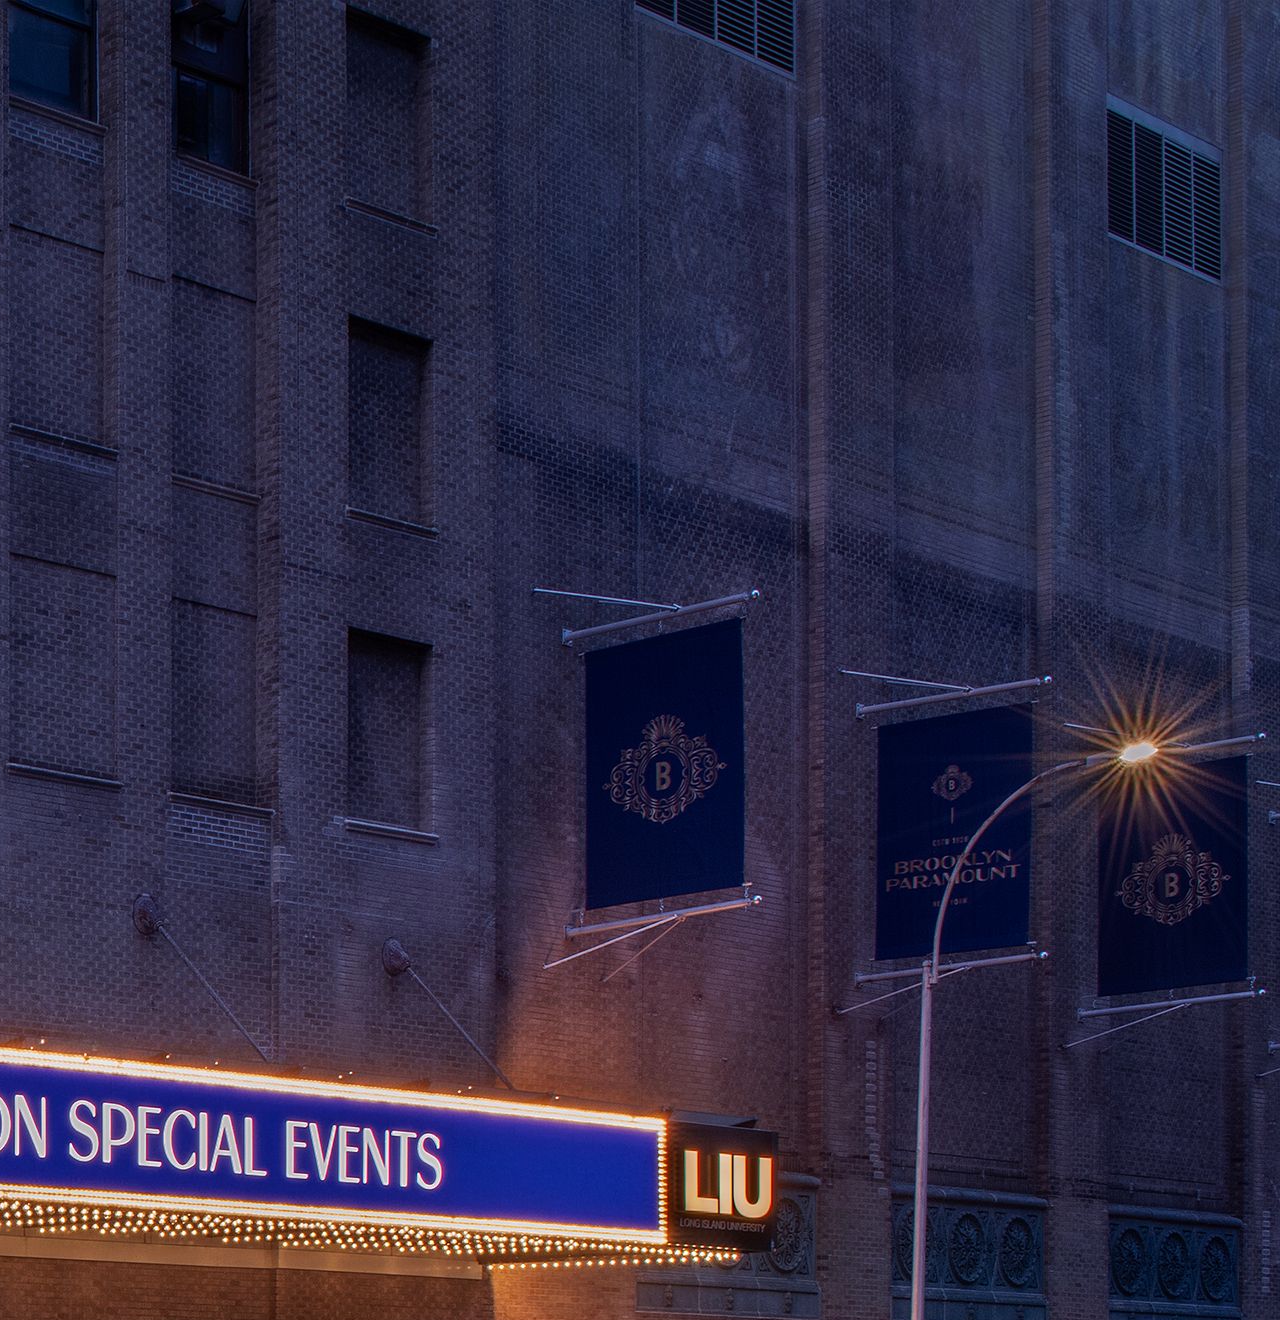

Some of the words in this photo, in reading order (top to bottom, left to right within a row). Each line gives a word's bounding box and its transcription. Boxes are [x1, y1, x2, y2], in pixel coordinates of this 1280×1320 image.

[656, 762, 671, 791] B
[1164, 873, 1180, 897] B
[66, 1098, 268, 1178] SPECIAL
[285, 1119, 444, 1190] EVENTS
[684, 1150, 773, 1219] LIU
[680, 1218, 700, 1228] LONG
[701, 1219, 726, 1230] ISLAND
[726, 1221, 766, 1233] UNIVERSITY
